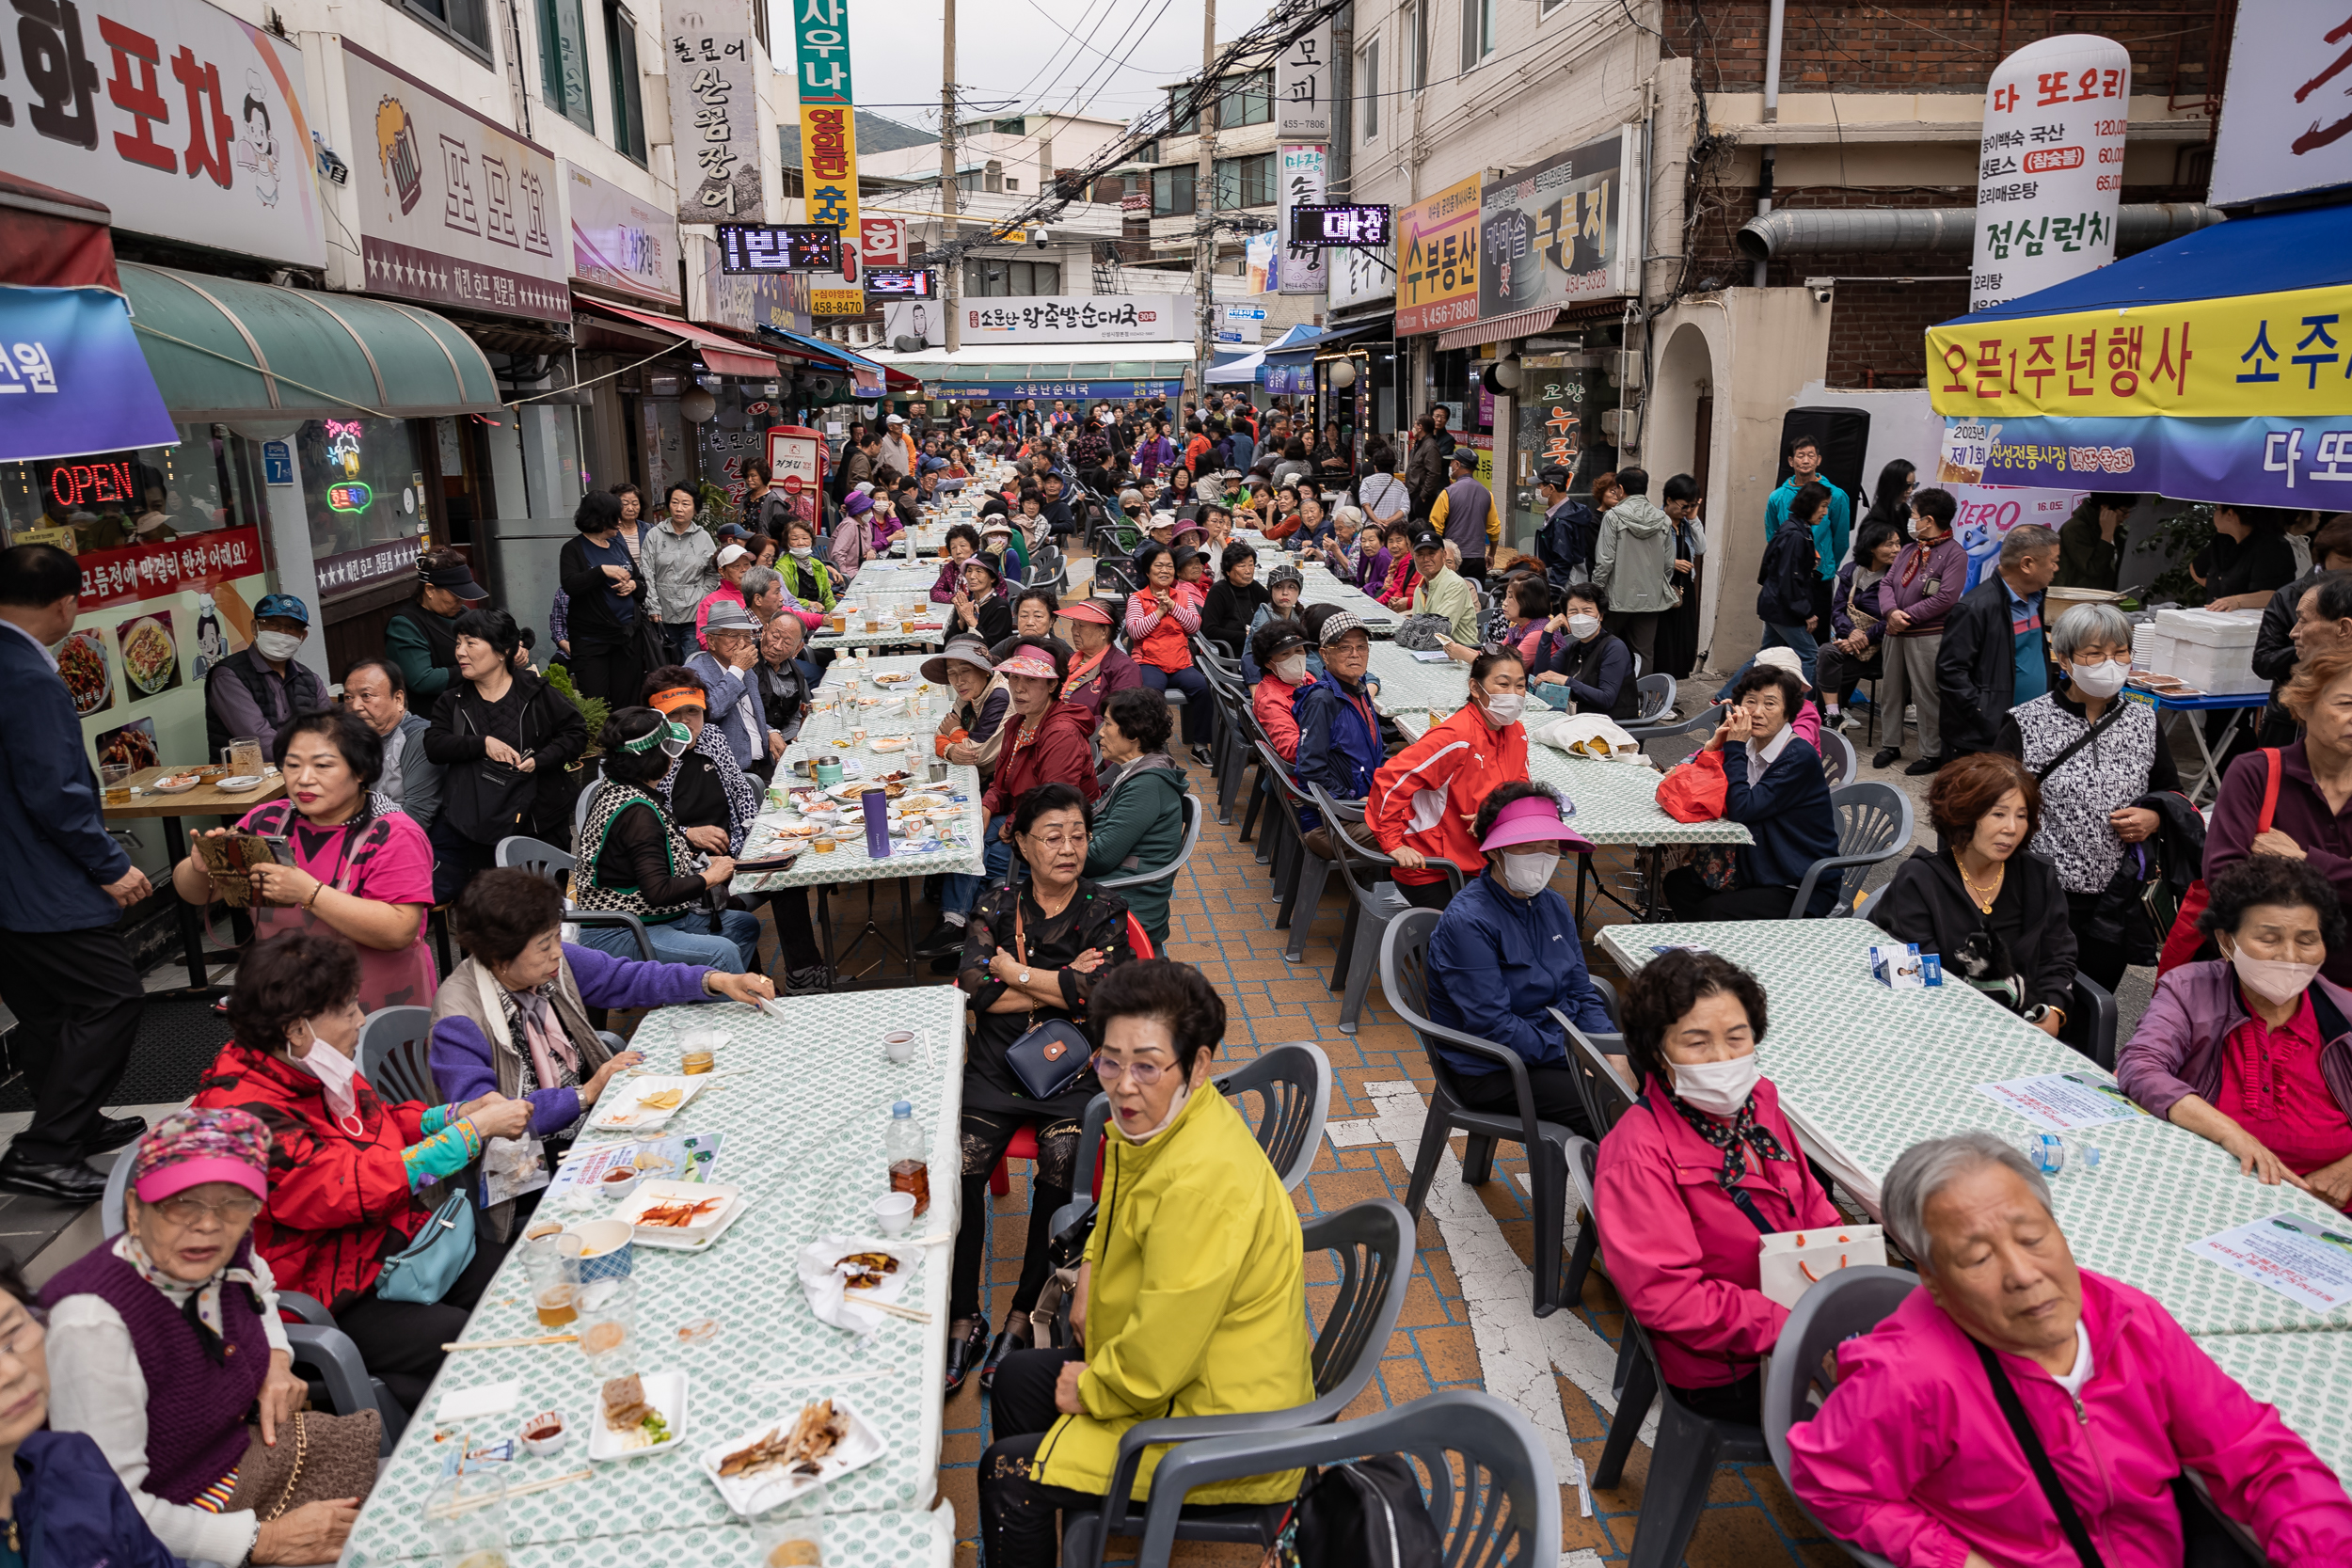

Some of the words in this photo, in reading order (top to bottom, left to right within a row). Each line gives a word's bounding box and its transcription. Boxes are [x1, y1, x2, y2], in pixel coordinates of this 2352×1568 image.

[673, 36, 746, 64] 돌문어
[800, 0, 848, 90] 사우나
[1994, 83, 2020, 114] 다
[2037, 67, 2126, 107] 또오리
[1282, 119, 1326, 130] 455-7806
[2029, 123, 2065, 143] 국산
[808, 109, 850, 181] 영일만
[1285, 151, 1323, 172] 마장
[2026, 148, 2082, 170] (참숯불)
[1979, 181, 2039, 205] 오리매운탕
[1324, 210, 1383, 241] 마장
[1486, 211, 1527, 265] 가마솥
[1533, 179, 1609, 273] 누룽지
[1987, 210, 2111, 261] 점심런치
[863, 220, 906, 264] 회
[472, 272, 492, 302] 호프
[493, 275, 516, 308] 전문점
[819, 290, 853, 299] 심야영업
[1565, 268, 1607, 294] 454-3328
[1974, 273, 2003, 291] 오리탕
[813, 301, 862, 313] 458-8470
[981, 309, 1020, 326] 소문난
[1429, 299, 1476, 326] 456-7880
[1943, 322, 2193, 399] 오픈1주년행사
[1542, 382, 1586, 403] 고향
[709, 433, 761, 451] 돌문어
[1953, 424, 1985, 441] 2023년
[1950, 445, 1987, 468] 제1회
[1990, 444, 2067, 472] 신성전통시장
[2263, 429, 2302, 489] 다
[51, 461, 135, 507] OPEN
[1957, 499, 2022, 531] ZERO
[2037, 501, 2064, 512] 16.0도
[80, 556, 139, 598] 모듬전에
[139, 551, 181, 587] 막걸리
[183, 546, 207, 578] 한잔
[360, 556, 374, 578] 호프
